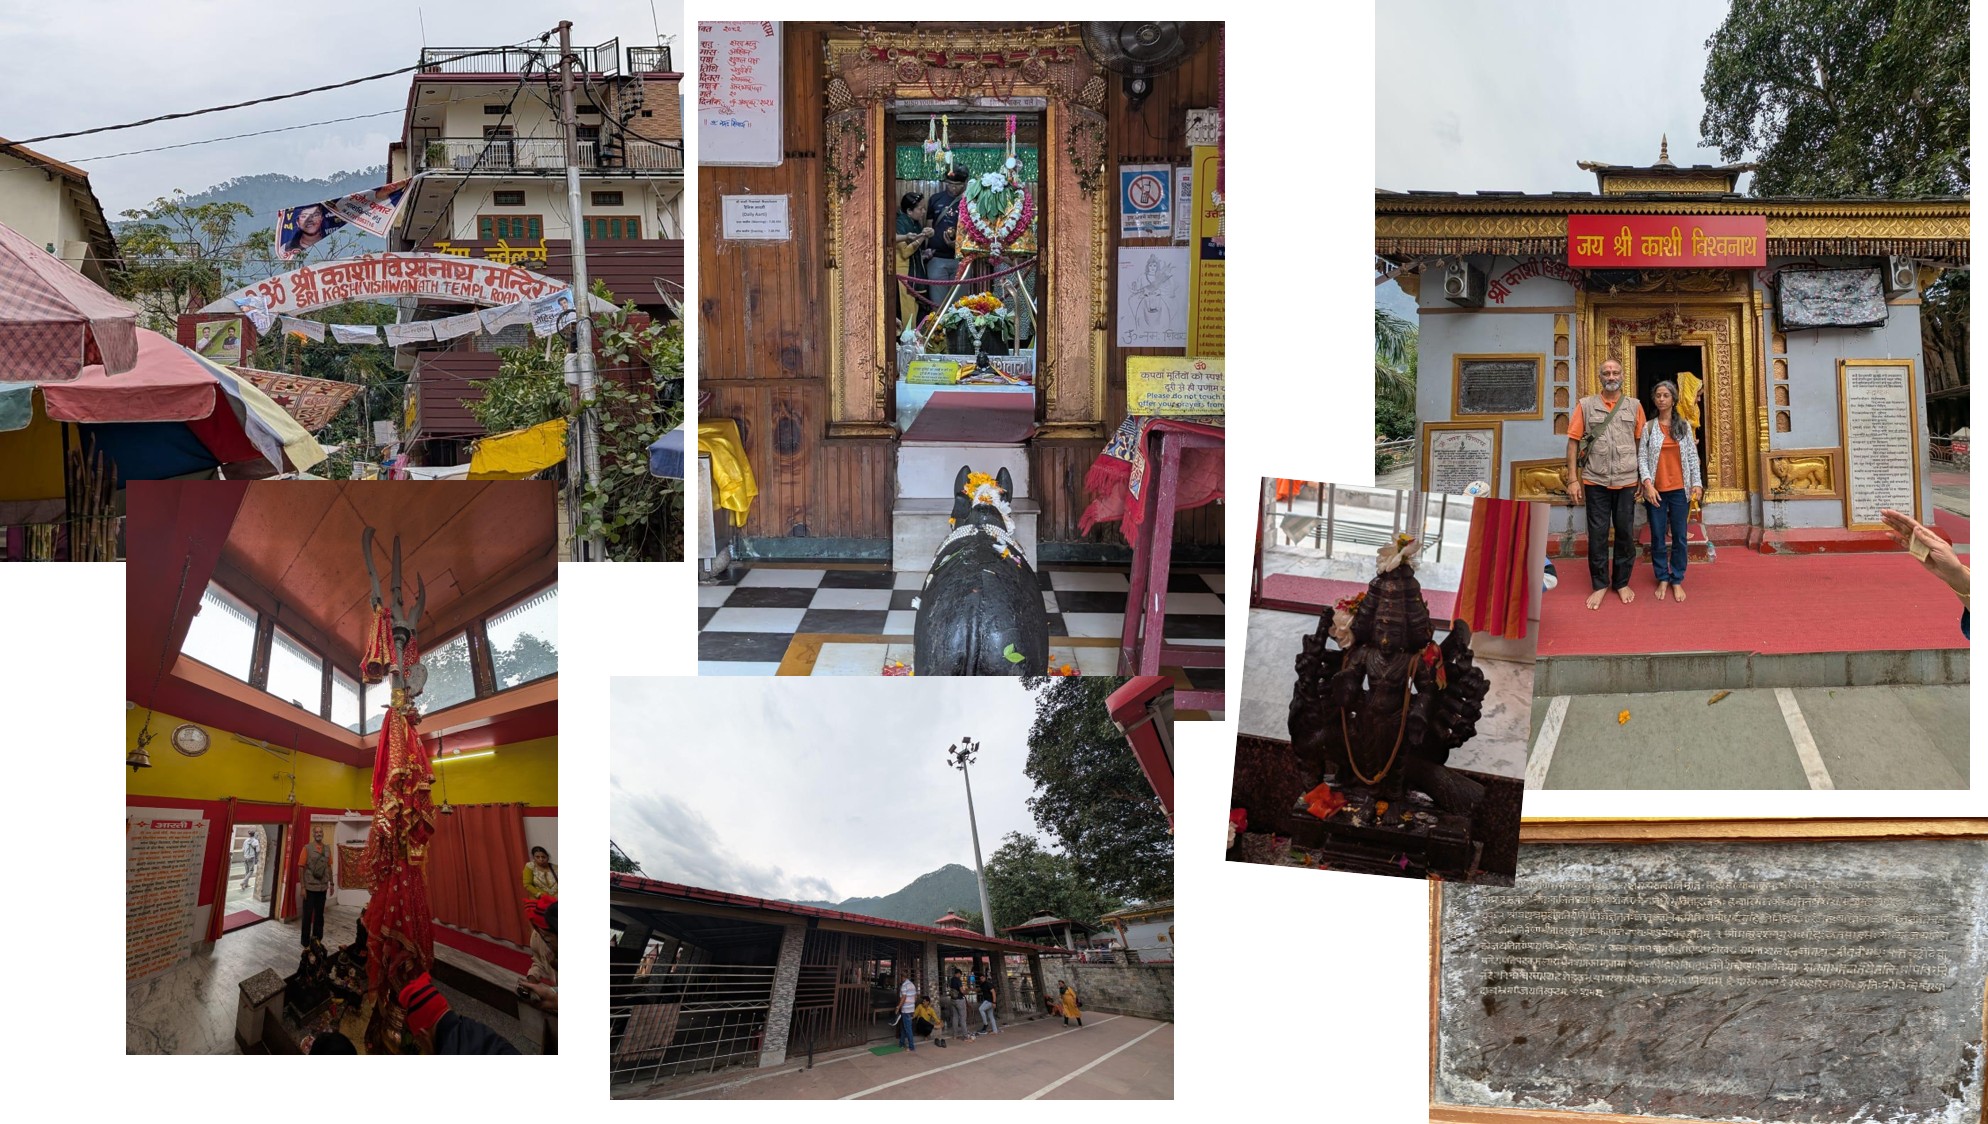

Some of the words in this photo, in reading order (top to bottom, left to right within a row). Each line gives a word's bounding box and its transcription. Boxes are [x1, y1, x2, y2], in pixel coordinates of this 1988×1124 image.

[1576, 234, 1604, 257] जय
[1613, 225, 1633, 257] श्री
[1641, 226, 1682, 257] काशी
[1691, 227, 1758, 257] विश्वनाथ
[291, 266, 317, 294] श्री
[317, 253, 380, 286] काशी
[380, 252, 479, 283] विश्वनाथ
[482, 265, 548, 300] मन्दिर
[1487, 279, 1512, 304] श्री
[1500, 256, 1540, 285] काशी
[296, 290, 320, 308] SRI
[322, 281, 361, 303] KASHI
[361, 279, 438, 296] VISHWANATH
[445, 281, 485, 299] TEMPL
[490, 288, 520, 305] ROAD
[1194, 360, 1207, 370] ॐ
[1191, 371, 1203, 380] को
[1164, 383, 1176, 392] दूरी
[1178, 383, 1185, 392] से
[1187, 383, 1195, 391] ही
[154, 821, 188, 830] आरती
